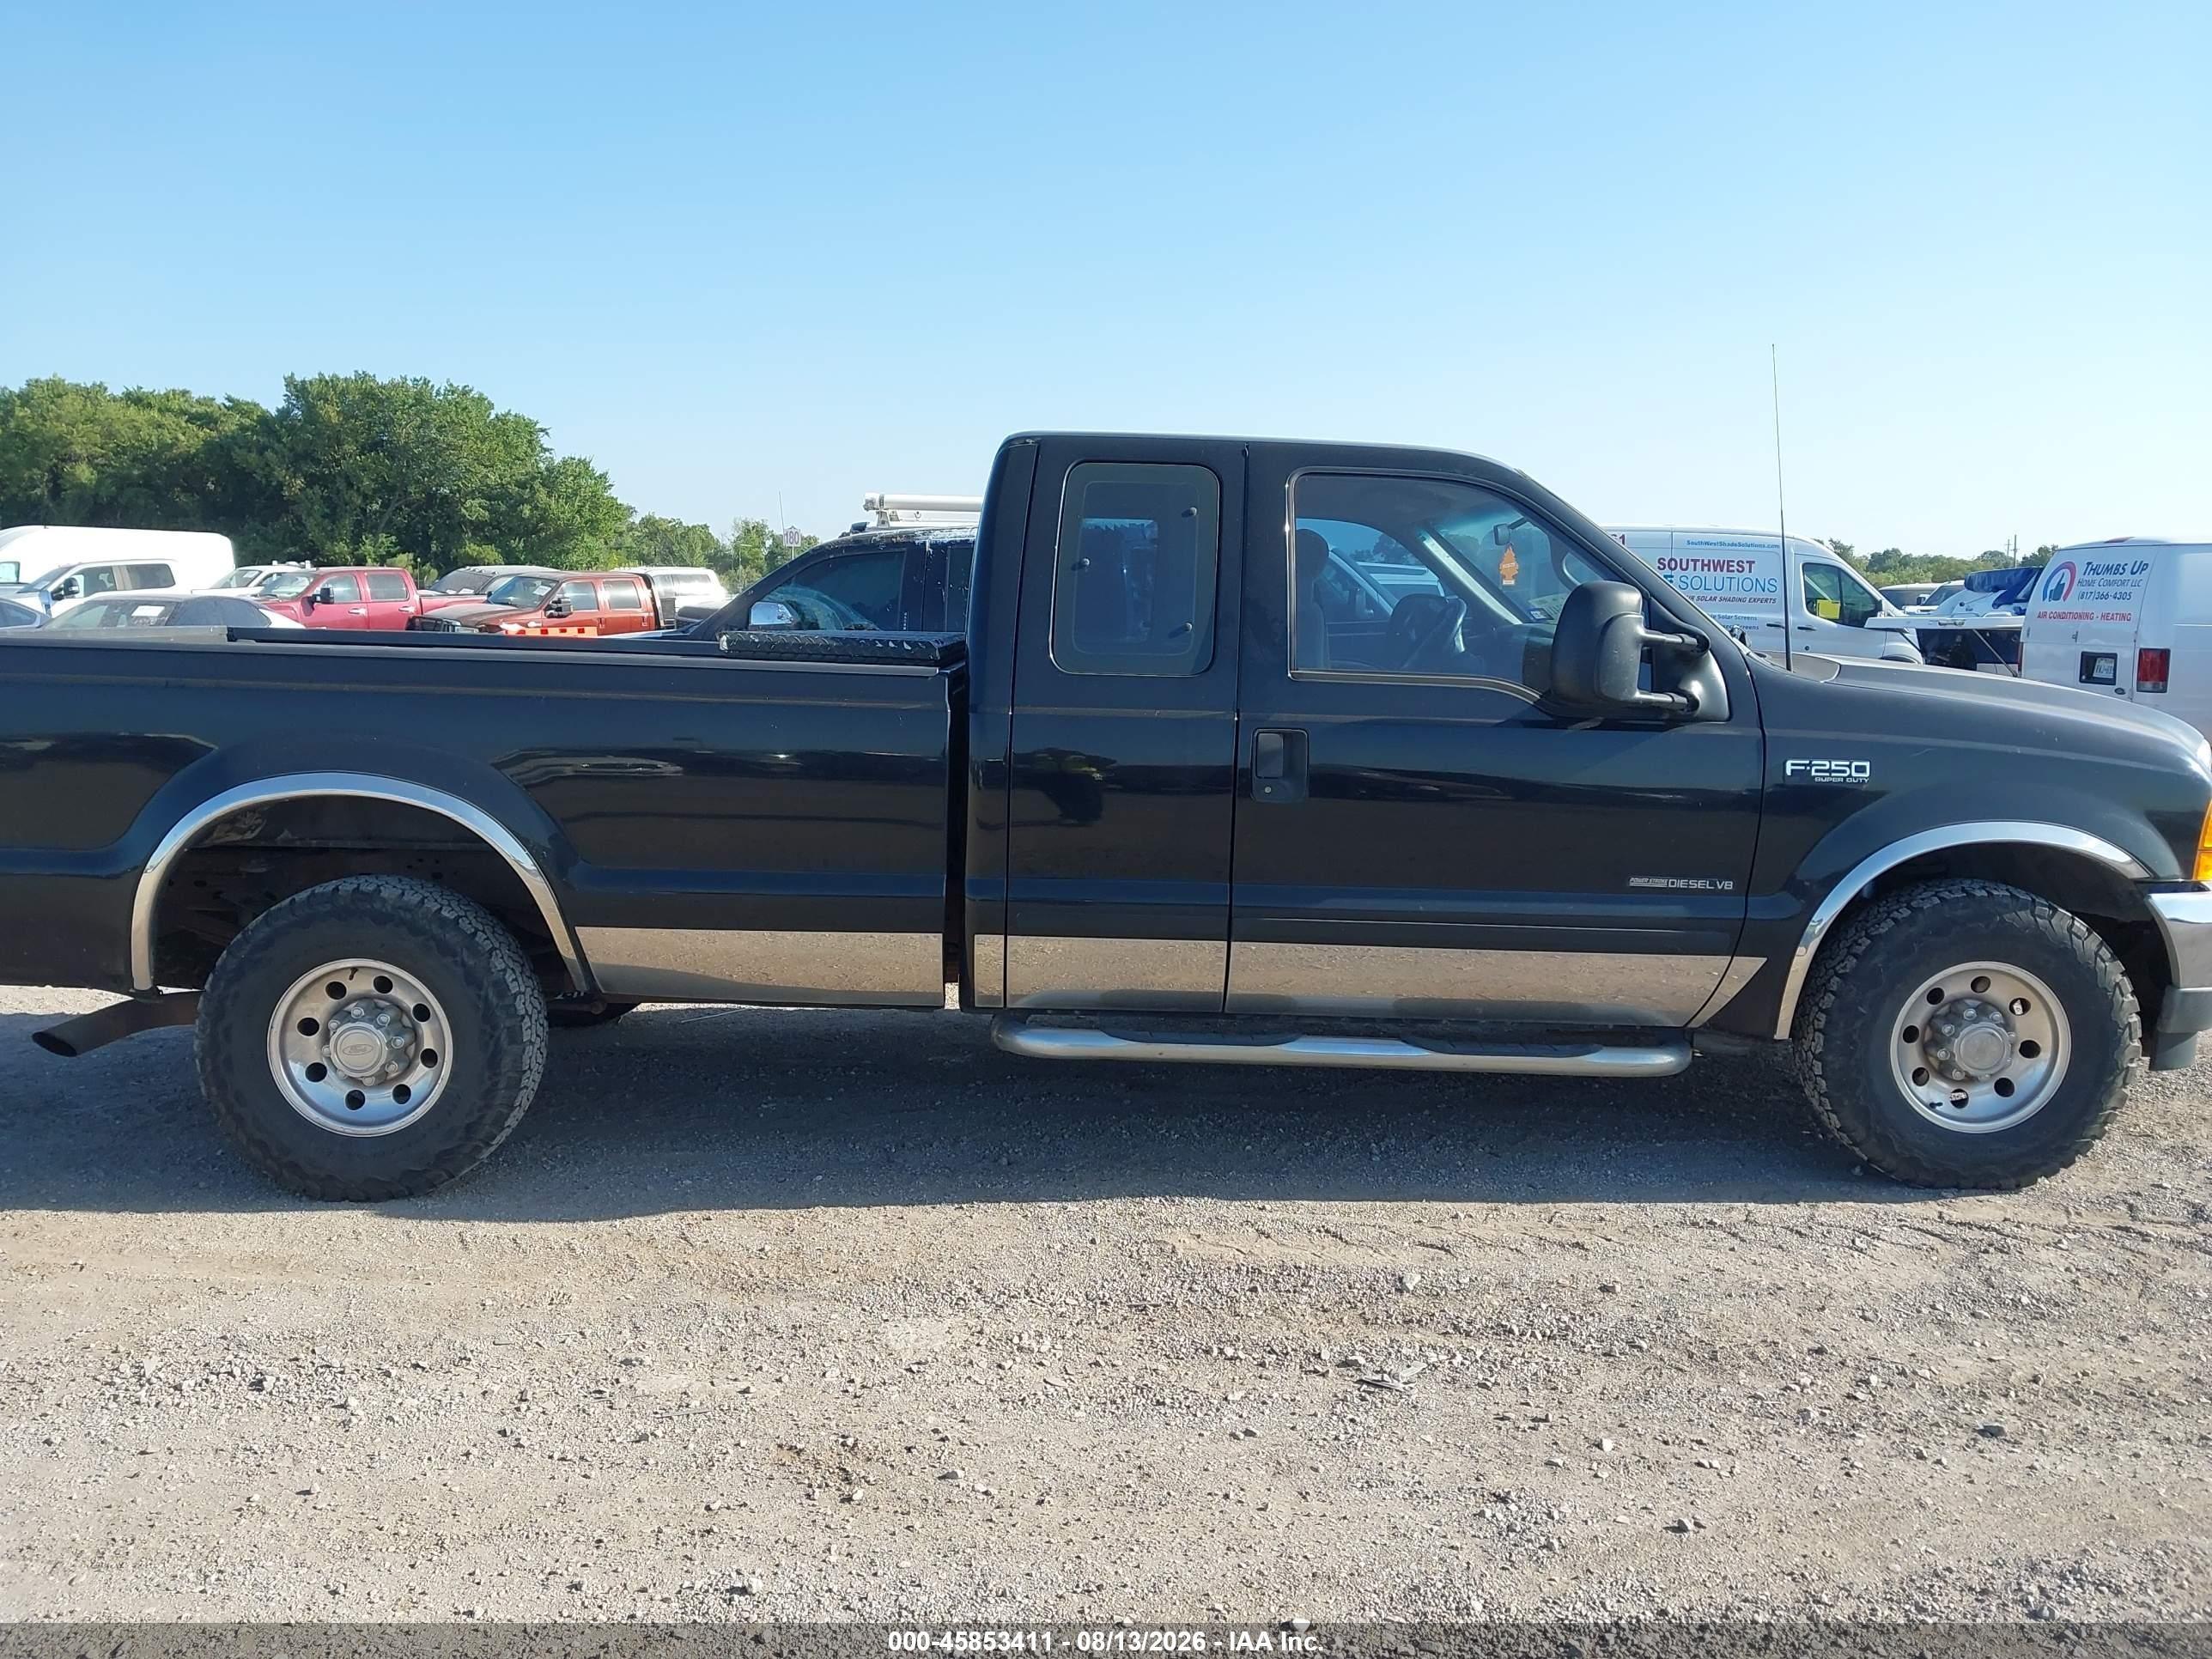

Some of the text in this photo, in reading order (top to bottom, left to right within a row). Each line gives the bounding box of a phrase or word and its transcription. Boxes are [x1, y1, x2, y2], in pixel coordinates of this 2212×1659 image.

[784, 531, 799, 544] 180
[1657, 557, 1756, 574] SOUTHWEST
[2083, 562, 2128, 575] THUMBS
[1678, 574, 1778, 592] SOLUTIONS
[2098, 577, 2130, 587] COMFORT
[2130, 579, 2143, 587] LLC
[2048, 611, 2094, 620] CONDITIONING
[2100, 612, 2131, 622] HEATING
[1668, 878, 1715, 889] DIESEL
[1717, 880, 1733, 890] V8
